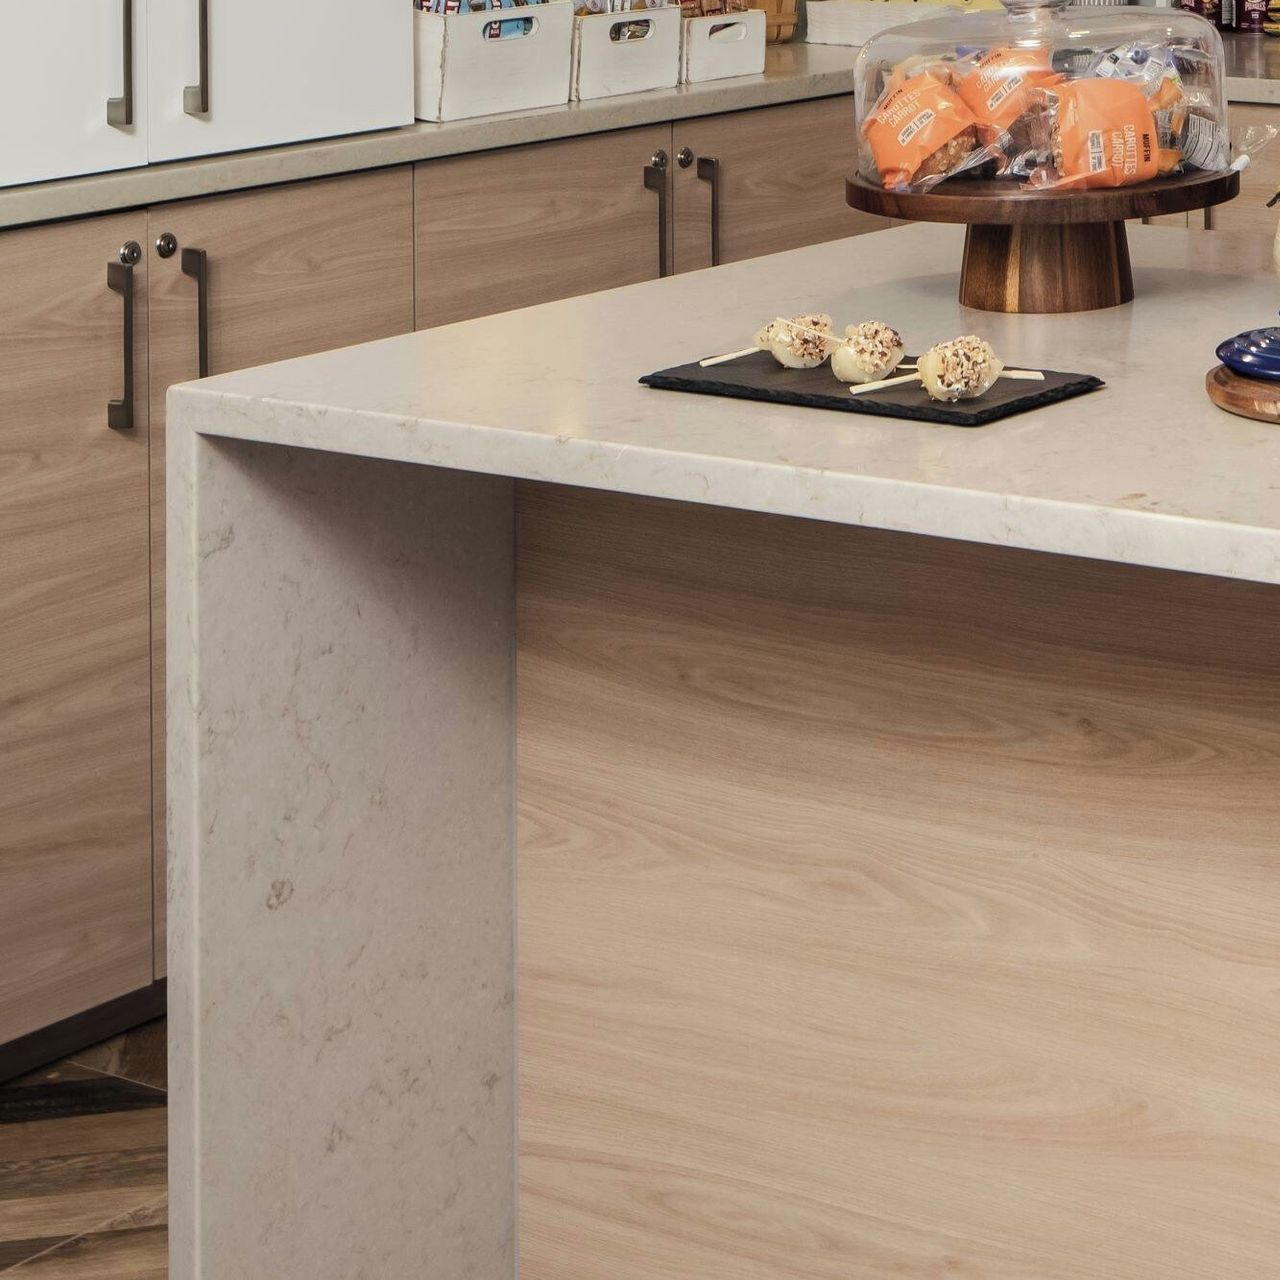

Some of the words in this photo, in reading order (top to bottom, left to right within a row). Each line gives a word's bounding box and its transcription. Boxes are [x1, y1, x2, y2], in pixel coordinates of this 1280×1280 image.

[876, 89, 922, 125] CAROTTES
[888, 101, 920, 128] CARROT
[1111, 131, 1123, 169] CARROT
[1124, 124, 1137, 176] CAROTTES
[1142, 133, 1150, 162] MUFFIN
